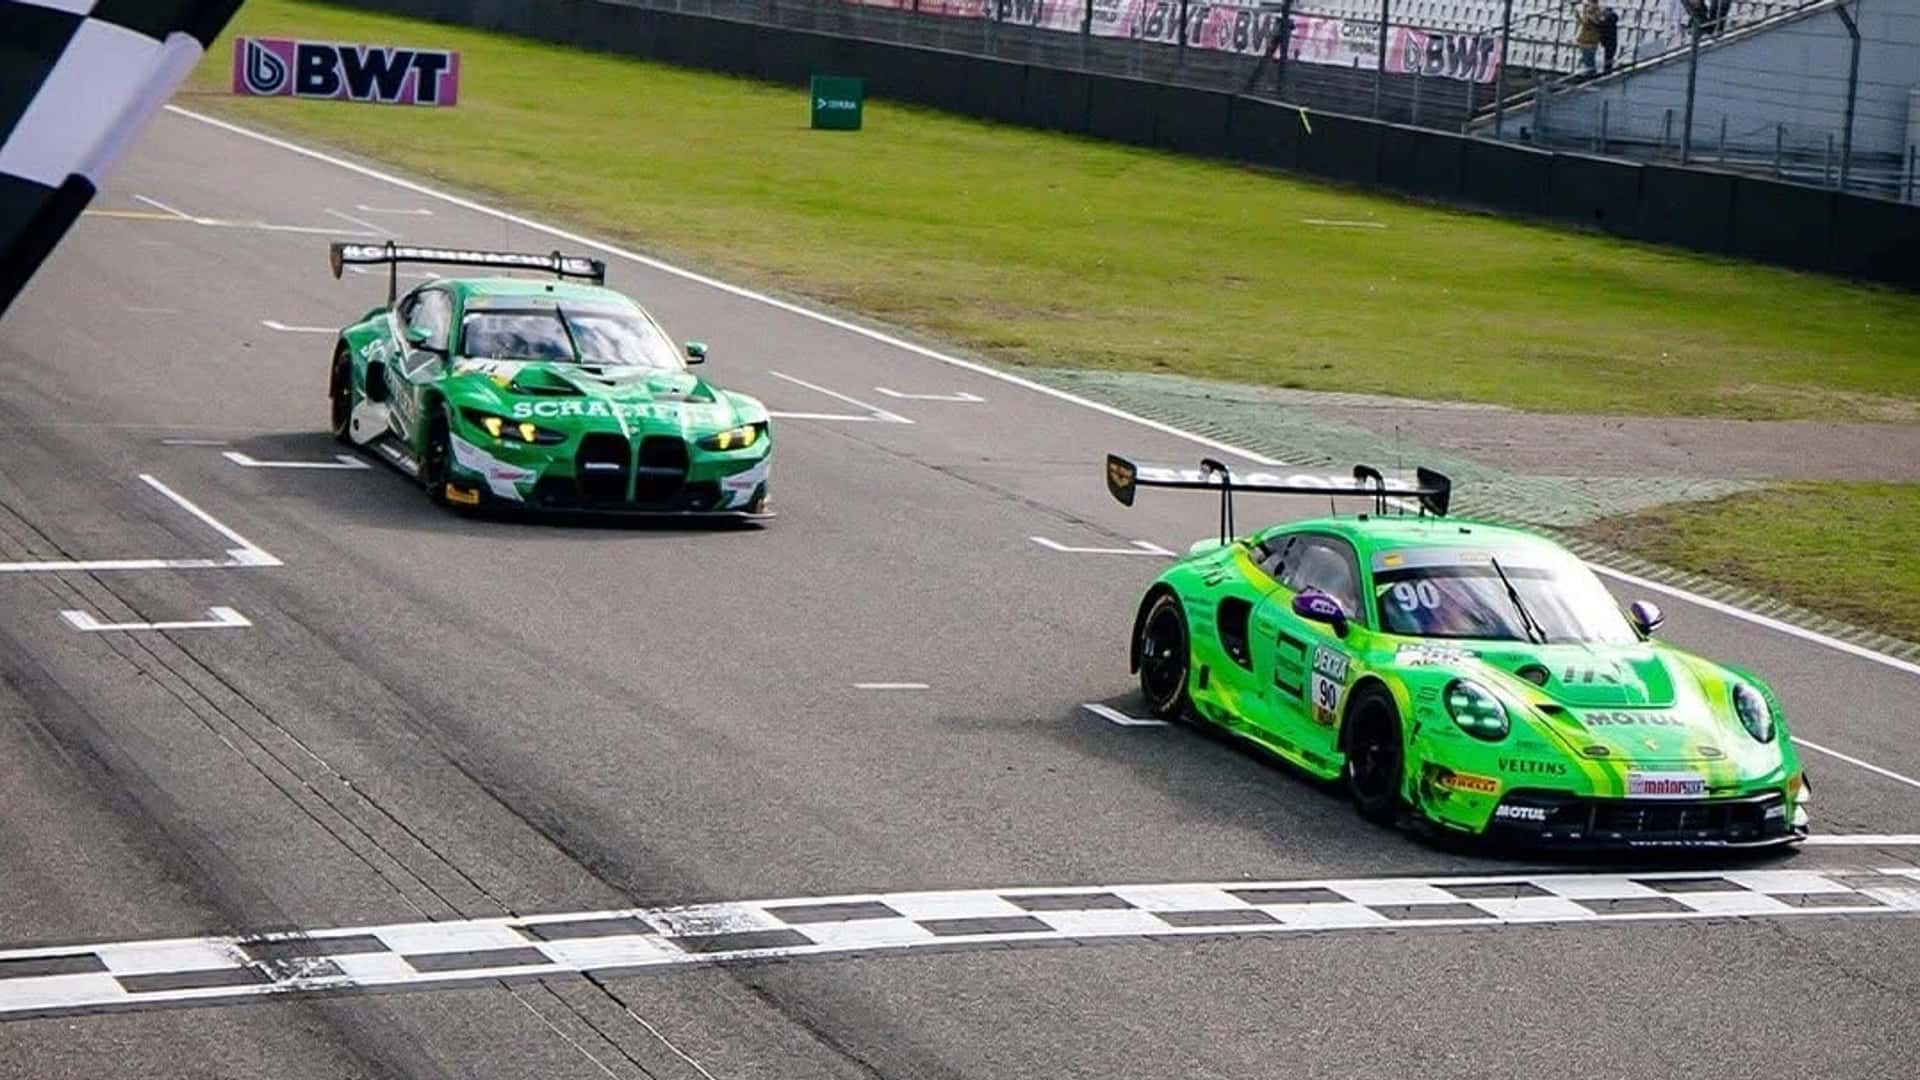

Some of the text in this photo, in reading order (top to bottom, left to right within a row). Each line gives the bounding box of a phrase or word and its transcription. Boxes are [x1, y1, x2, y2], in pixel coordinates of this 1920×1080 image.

[297, 43, 449, 103] BWT
[1423, 34, 1494, 81] BWT
[1393, 579, 1440, 612] 90
[1320, 679, 1337, 711] 90
[1498, 757, 1568, 776] VELTINS
[1495, 803, 1547, 821] MOTUL
